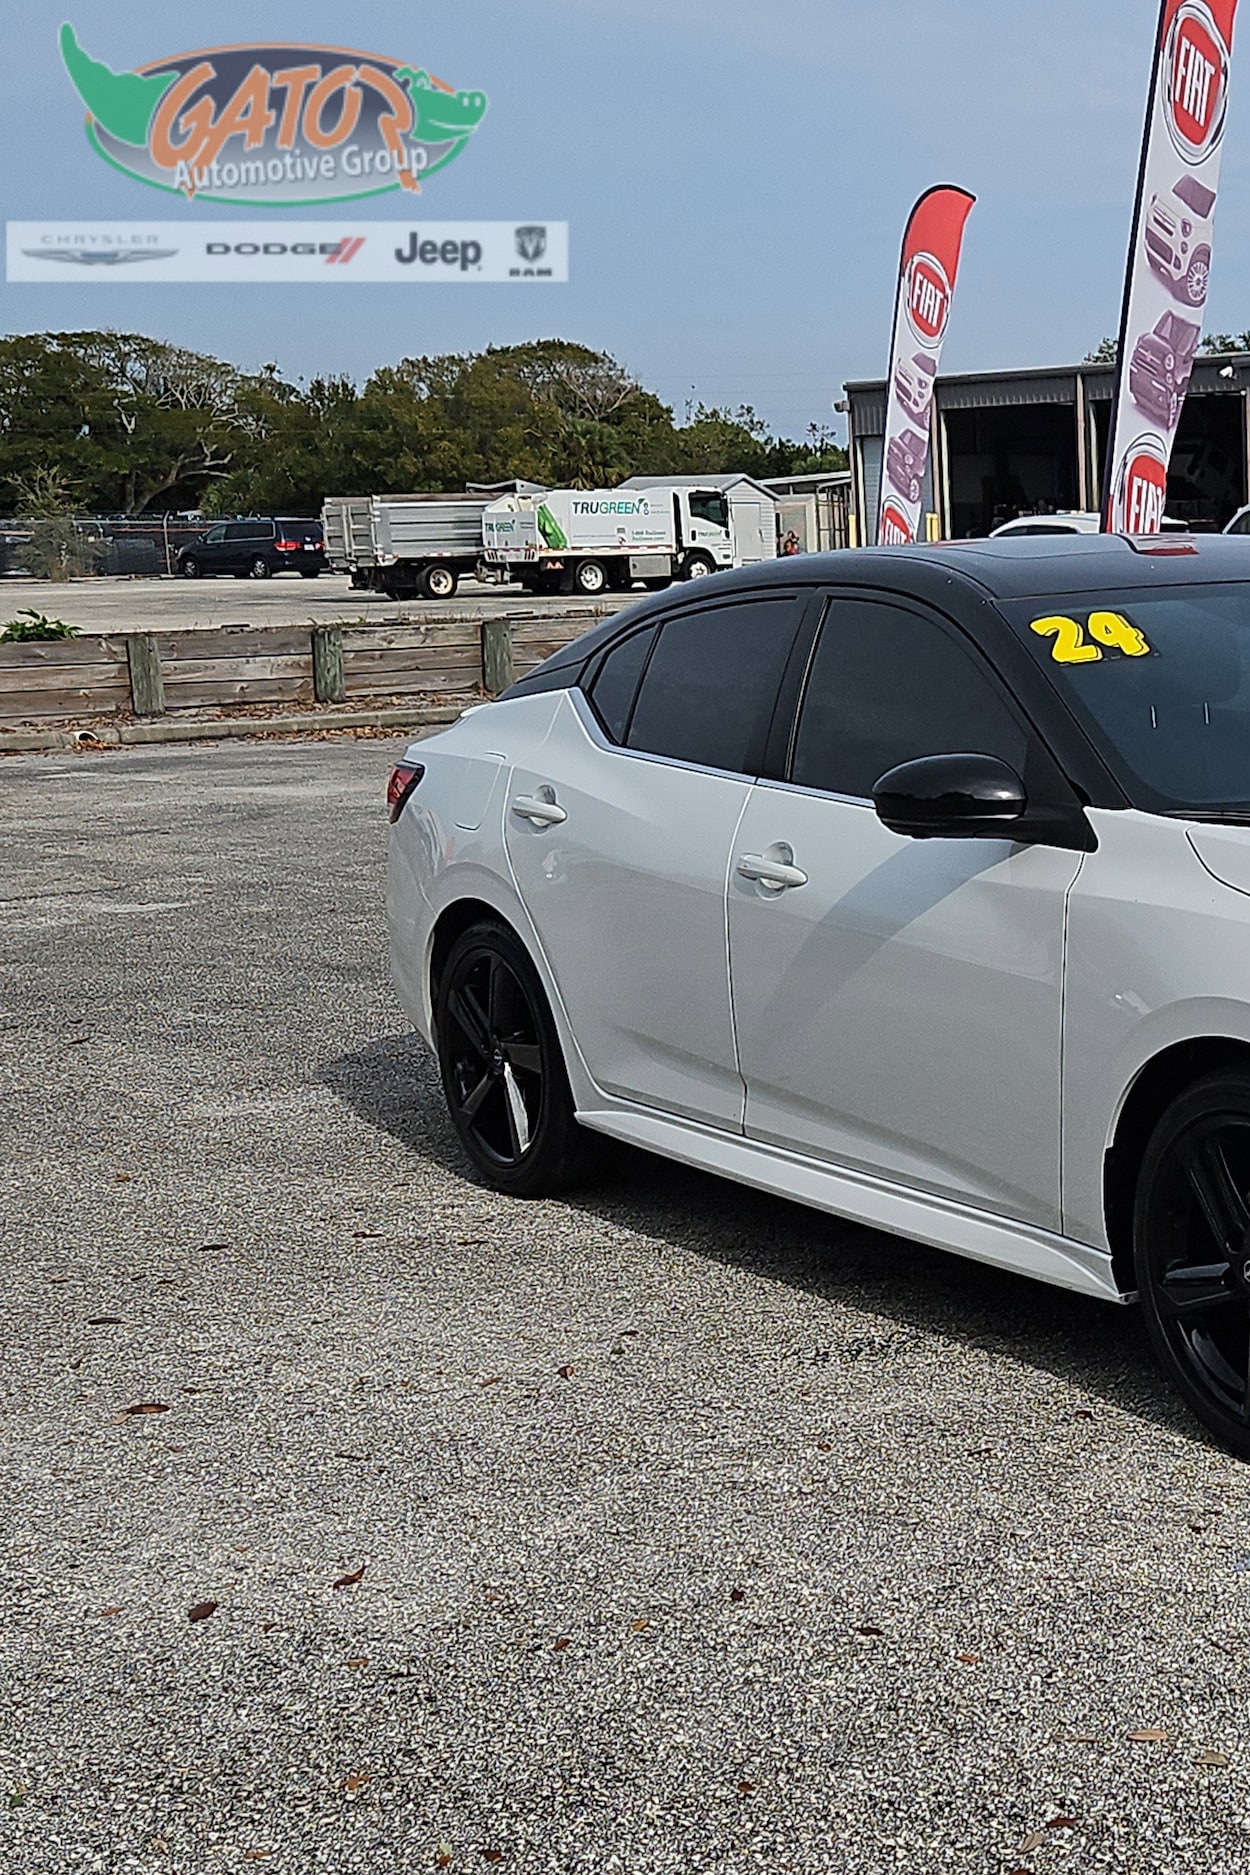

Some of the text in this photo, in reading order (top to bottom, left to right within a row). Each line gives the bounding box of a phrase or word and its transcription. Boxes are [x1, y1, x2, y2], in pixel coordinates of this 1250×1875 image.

[1174, 35, 1216, 127] FIAT
[912, 271, 944, 328] FIAT
[572, 501, 642, 515] TRUGREEN
[1030, 611, 1150, 664] 24
